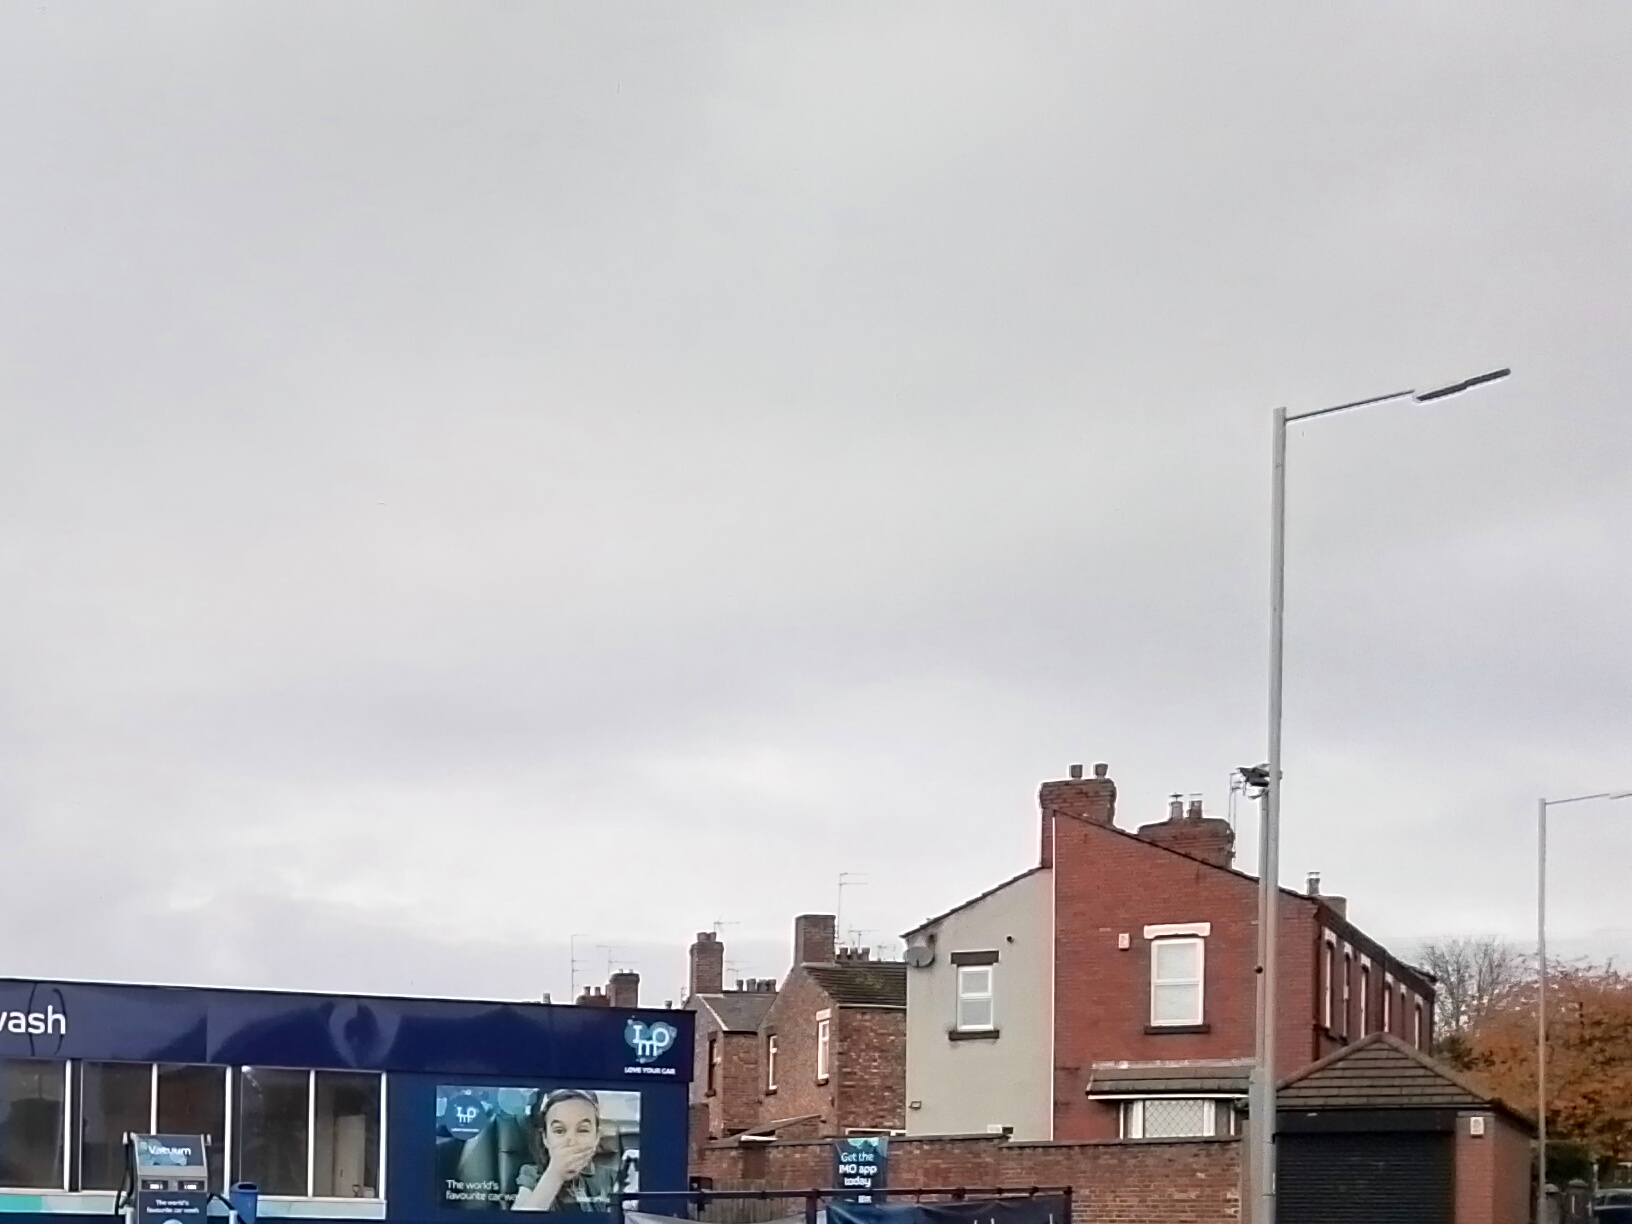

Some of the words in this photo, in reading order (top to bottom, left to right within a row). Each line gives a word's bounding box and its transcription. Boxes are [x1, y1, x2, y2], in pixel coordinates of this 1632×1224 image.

[624, 1066, 642, 1074] LOVE
[642, 1067, 661, 1075] YOUR
[661, 1068, 677, 1076] CAR
[148, 1145, 192, 1156] Vacuum
[841, 1152, 858, 1163] Get
[858, 1151, 875, 1162] the
[858, 1165, 878, 1176] app
[445, 1179, 465, 1190] The
[465, 1180, 500, 1191] world's
[843, 1175, 872, 1188] today
[445, 1190, 487, 1201] favourite
